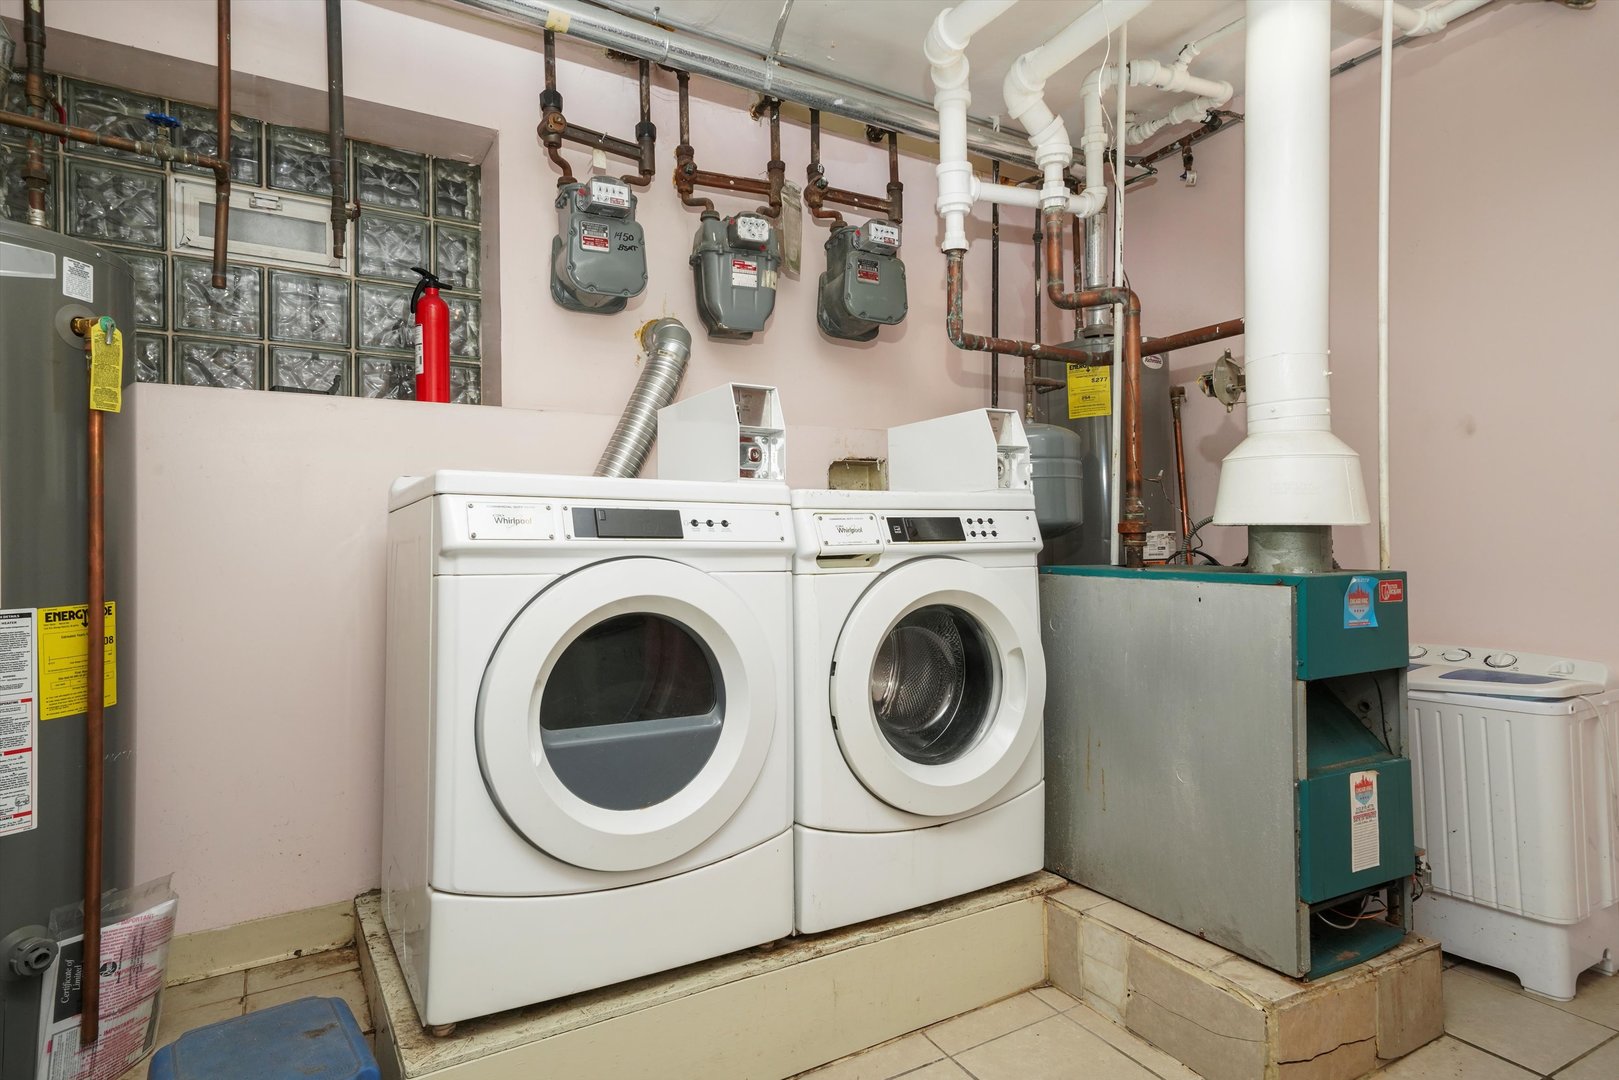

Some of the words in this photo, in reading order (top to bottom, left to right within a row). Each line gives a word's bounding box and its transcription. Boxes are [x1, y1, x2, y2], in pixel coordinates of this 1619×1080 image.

[613, 231, 634, 242] 1450
[494, 517, 532, 526] Whirlpool
[60, 967, 73, 1004] Certificate
[72, 964, 82, 991] Limited
